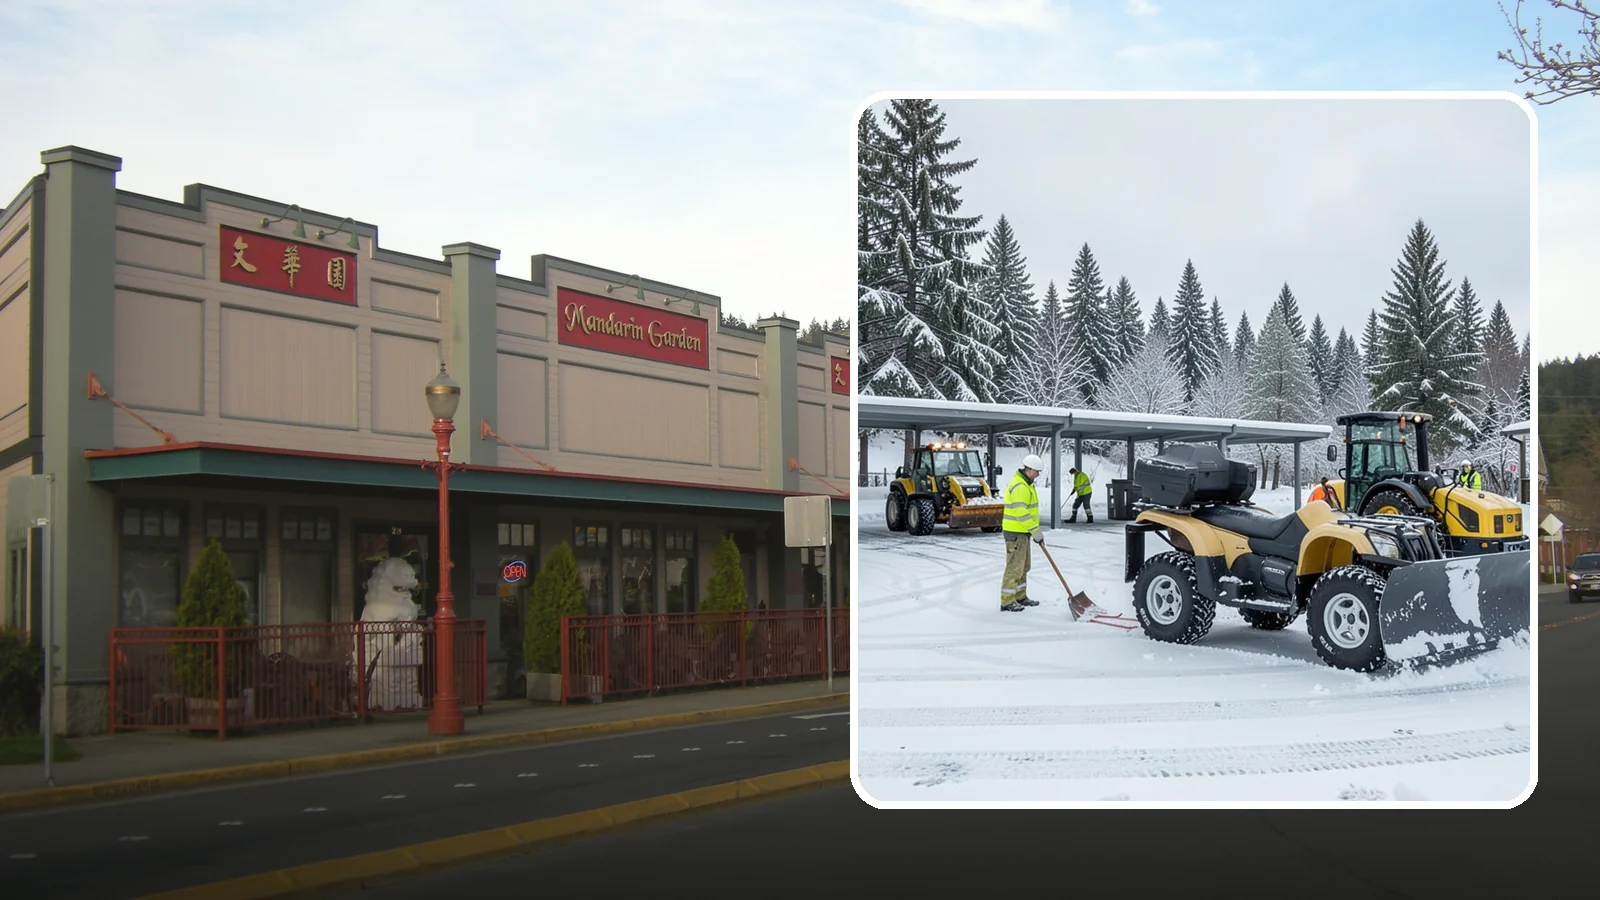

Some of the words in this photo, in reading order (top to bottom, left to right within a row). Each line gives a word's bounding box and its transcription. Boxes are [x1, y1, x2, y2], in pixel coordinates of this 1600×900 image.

[564, 302, 644, 341] Mandarin
[647, 320, 702, 352] Garden
[503, 565, 527, 578] OPEN
